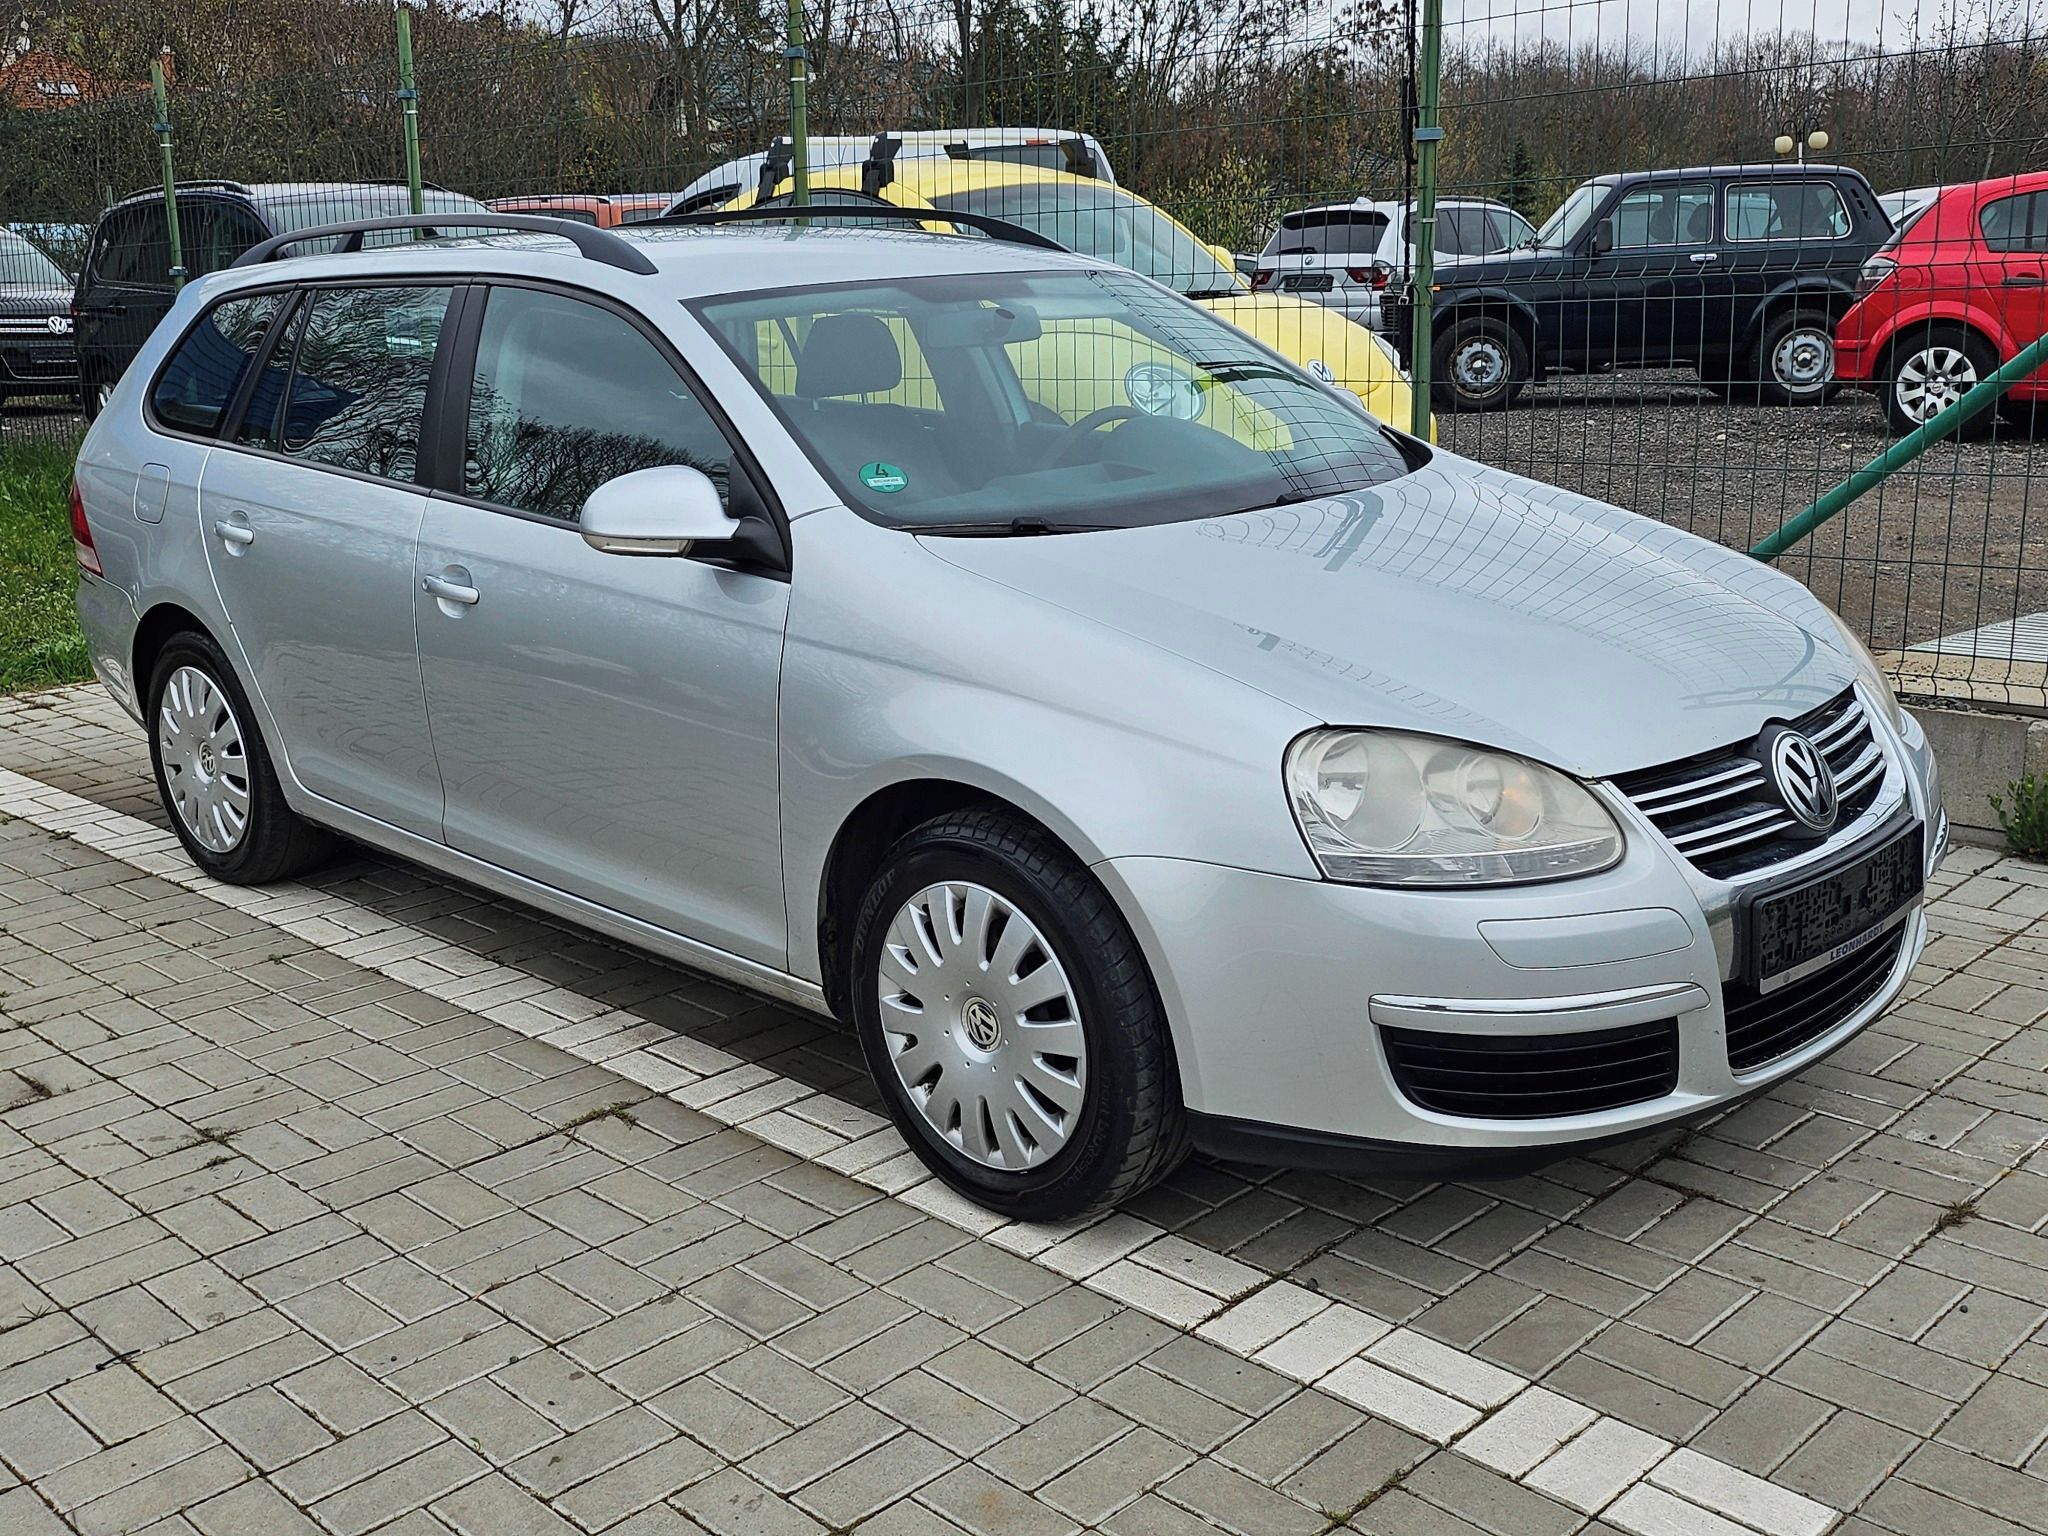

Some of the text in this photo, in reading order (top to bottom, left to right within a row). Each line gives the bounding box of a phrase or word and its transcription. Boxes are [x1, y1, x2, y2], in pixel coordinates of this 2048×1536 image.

[876, 463, 889, 477] 4
[1775, 733, 1836, 826] VW
[856, 868, 895, 951] DUNLOP
[1830, 922, 1884, 961] LEONHARDT
